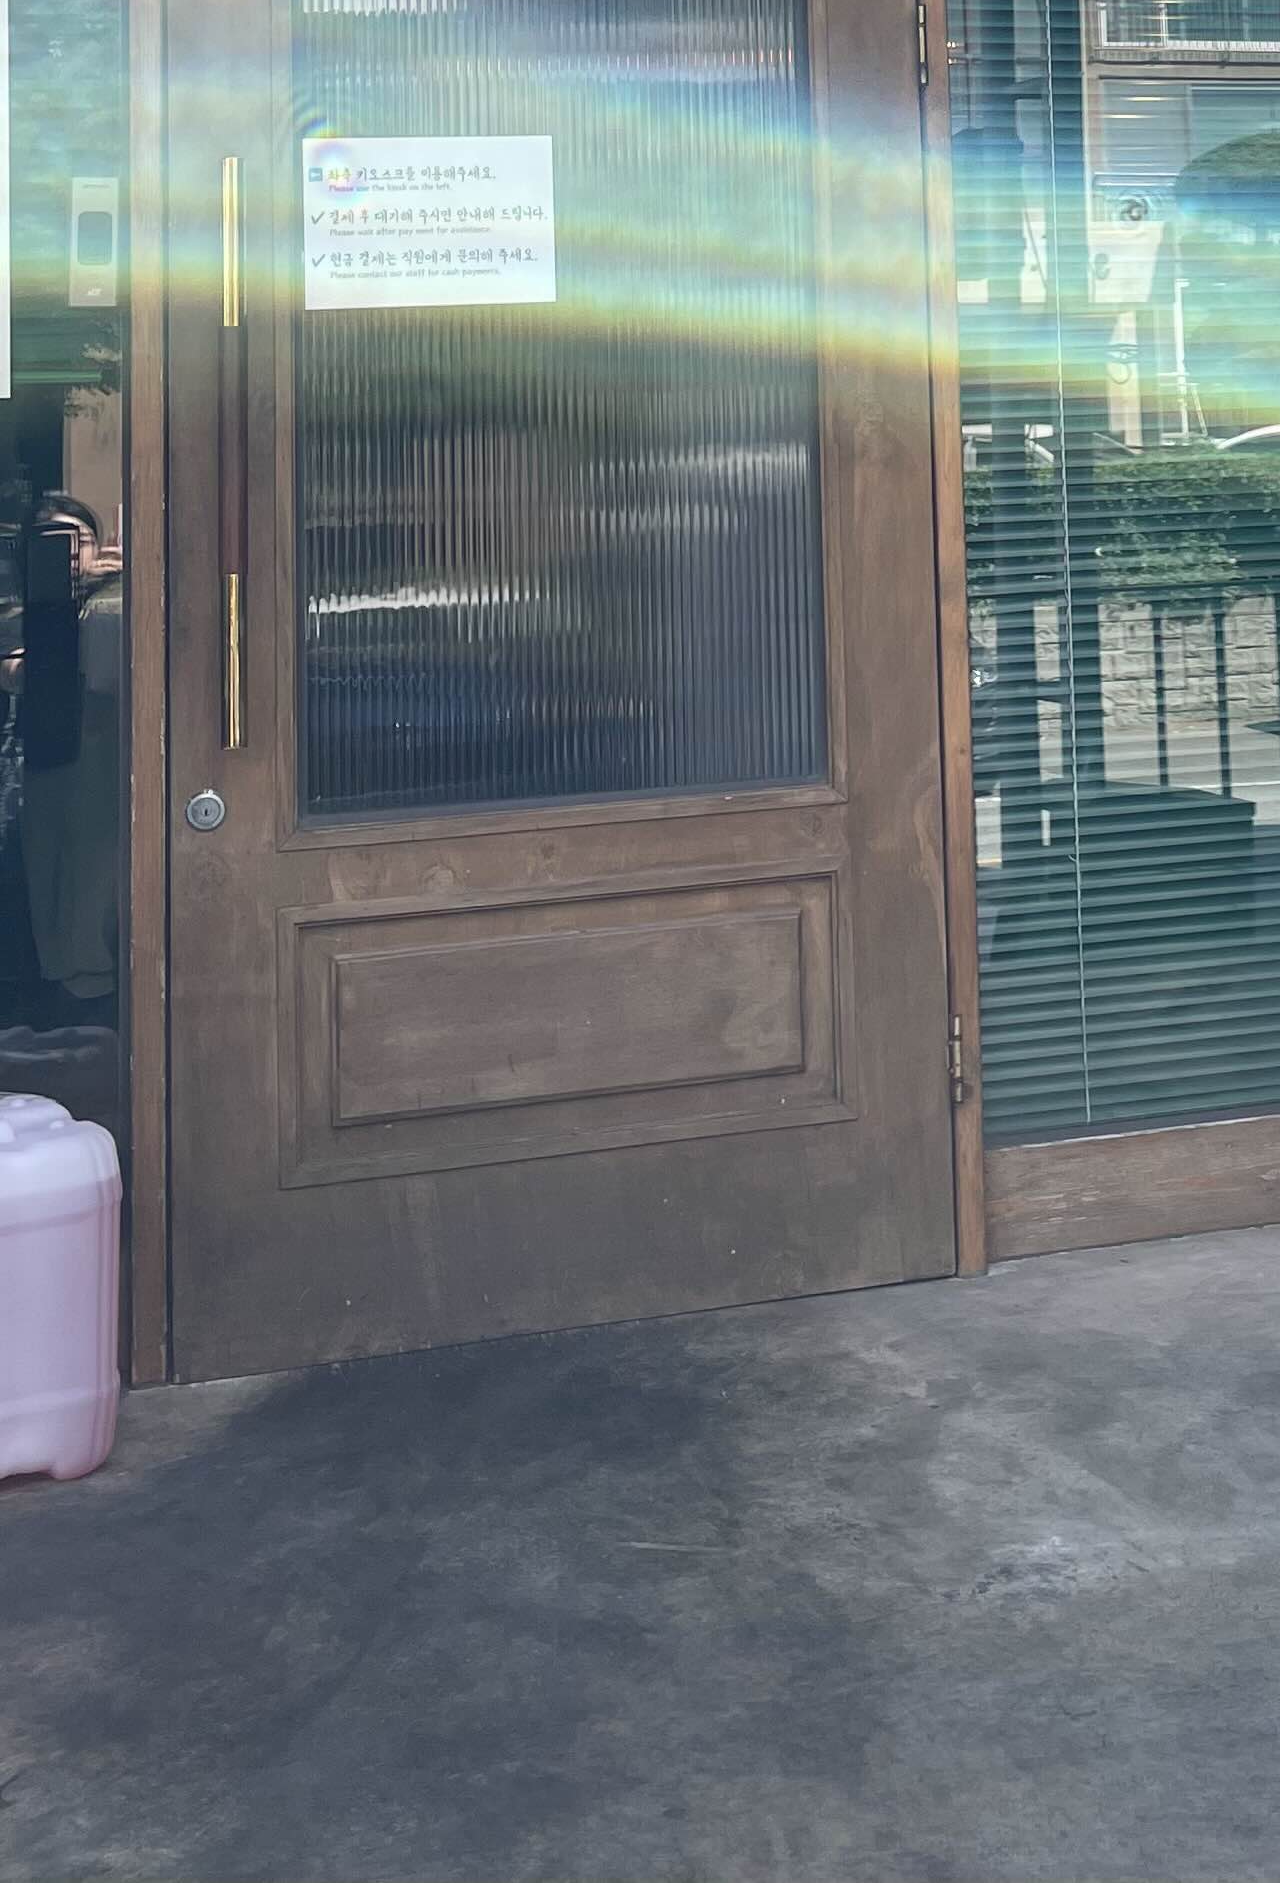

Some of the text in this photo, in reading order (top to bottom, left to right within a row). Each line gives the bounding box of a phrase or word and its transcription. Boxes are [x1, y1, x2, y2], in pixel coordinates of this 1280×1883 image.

[357, 166, 415, 181] 키오스크를
[374, 208, 413, 224] 대기해
[457, 206, 495, 222] 안내해
